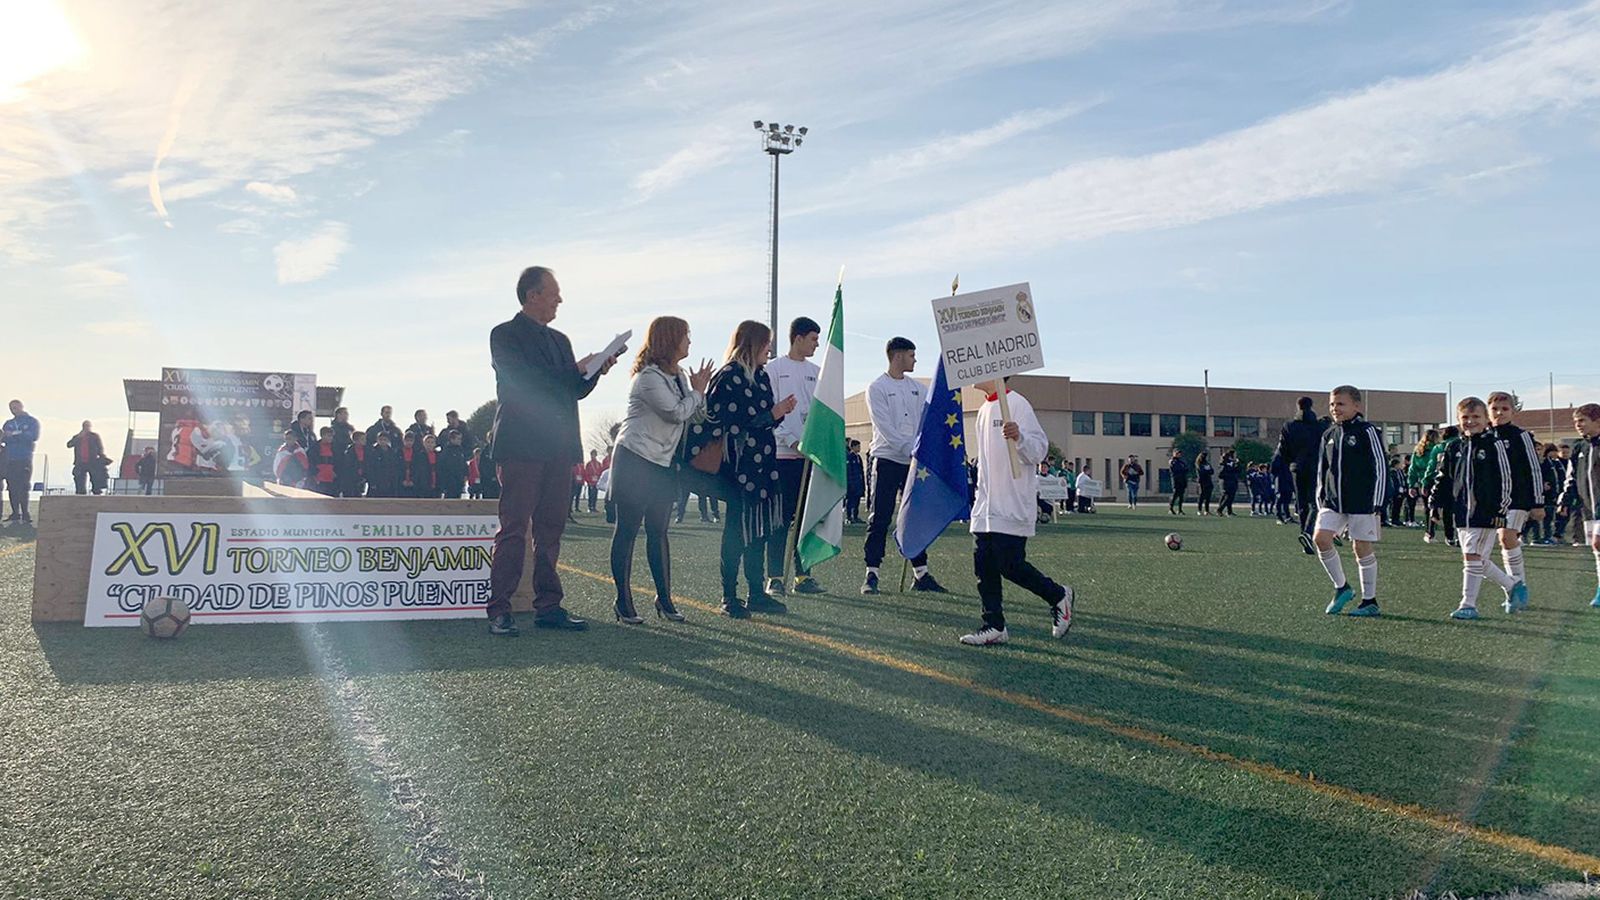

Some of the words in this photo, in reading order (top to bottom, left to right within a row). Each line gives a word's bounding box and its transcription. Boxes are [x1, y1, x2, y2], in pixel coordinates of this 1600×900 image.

[937, 306, 959, 324] XVI
[946, 347, 983, 366] REAL
[985, 332, 1038, 357] MADRID
[163, 369, 190, 383] XVI
[957, 365, 982, 381] CLUB
[985, 361, 998, 373] DE
[1000, 353, 1035, 371] FÚTBOL
[231, 528, 279, 537] ESTADIO
[283, 528, 345, 537] MUNICIPAL
[352, 524, 424, 537] "EMILIO
[432, 524, 497, 537] BAENA"
[105, 522, 220, 576] XVI
[227, 547, 352, 573] TORNEO
[357, 546, 493, 578] BENJAMIN
[249, 583, 291, 610] DE
[295, 580, 379, 608] PINOS
